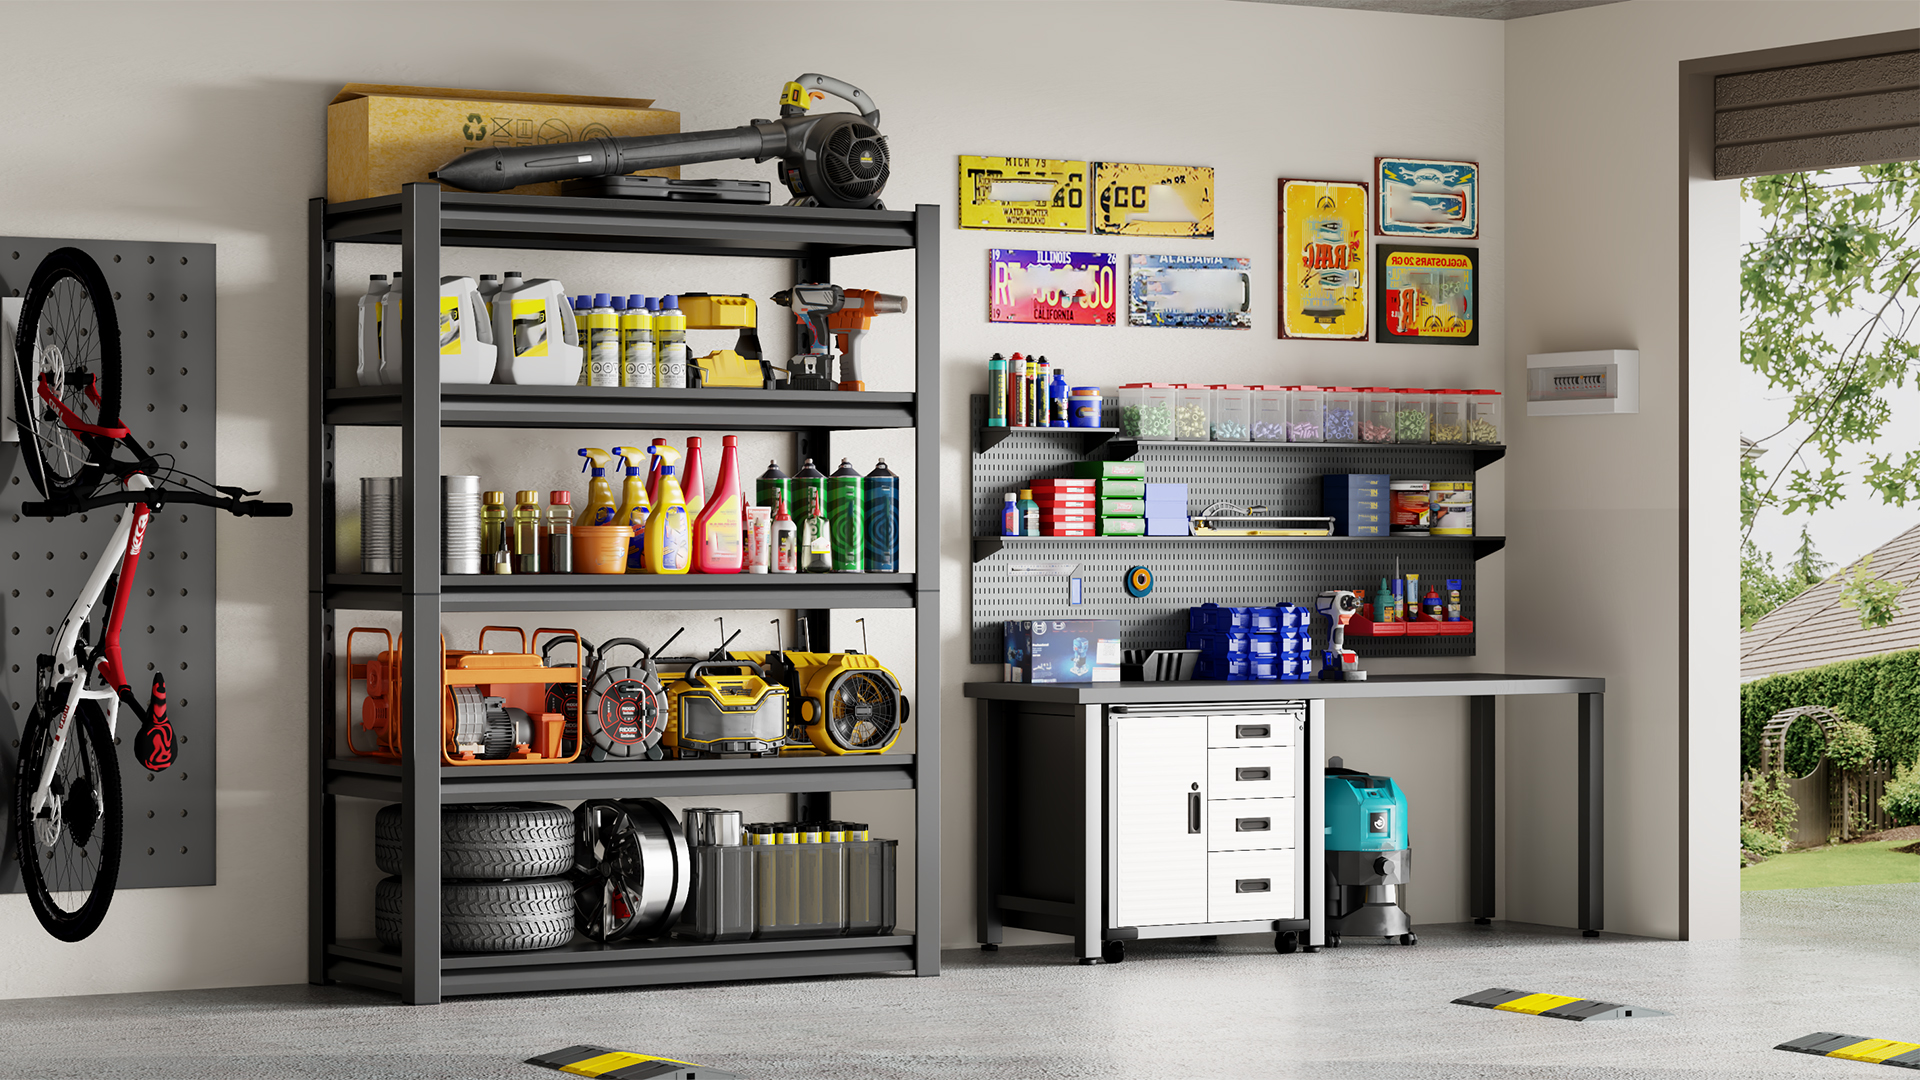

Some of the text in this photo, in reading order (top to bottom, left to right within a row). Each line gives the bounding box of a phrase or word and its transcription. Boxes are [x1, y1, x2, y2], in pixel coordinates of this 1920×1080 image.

[992, 249, 1117, 264] 19 ILLINOIS 26
[1159, 255, 1223, 264] ALABAMA
[1033, 308, 1075, 320] CALIFORNIA
[1106, 312, 1116, 323] 85
